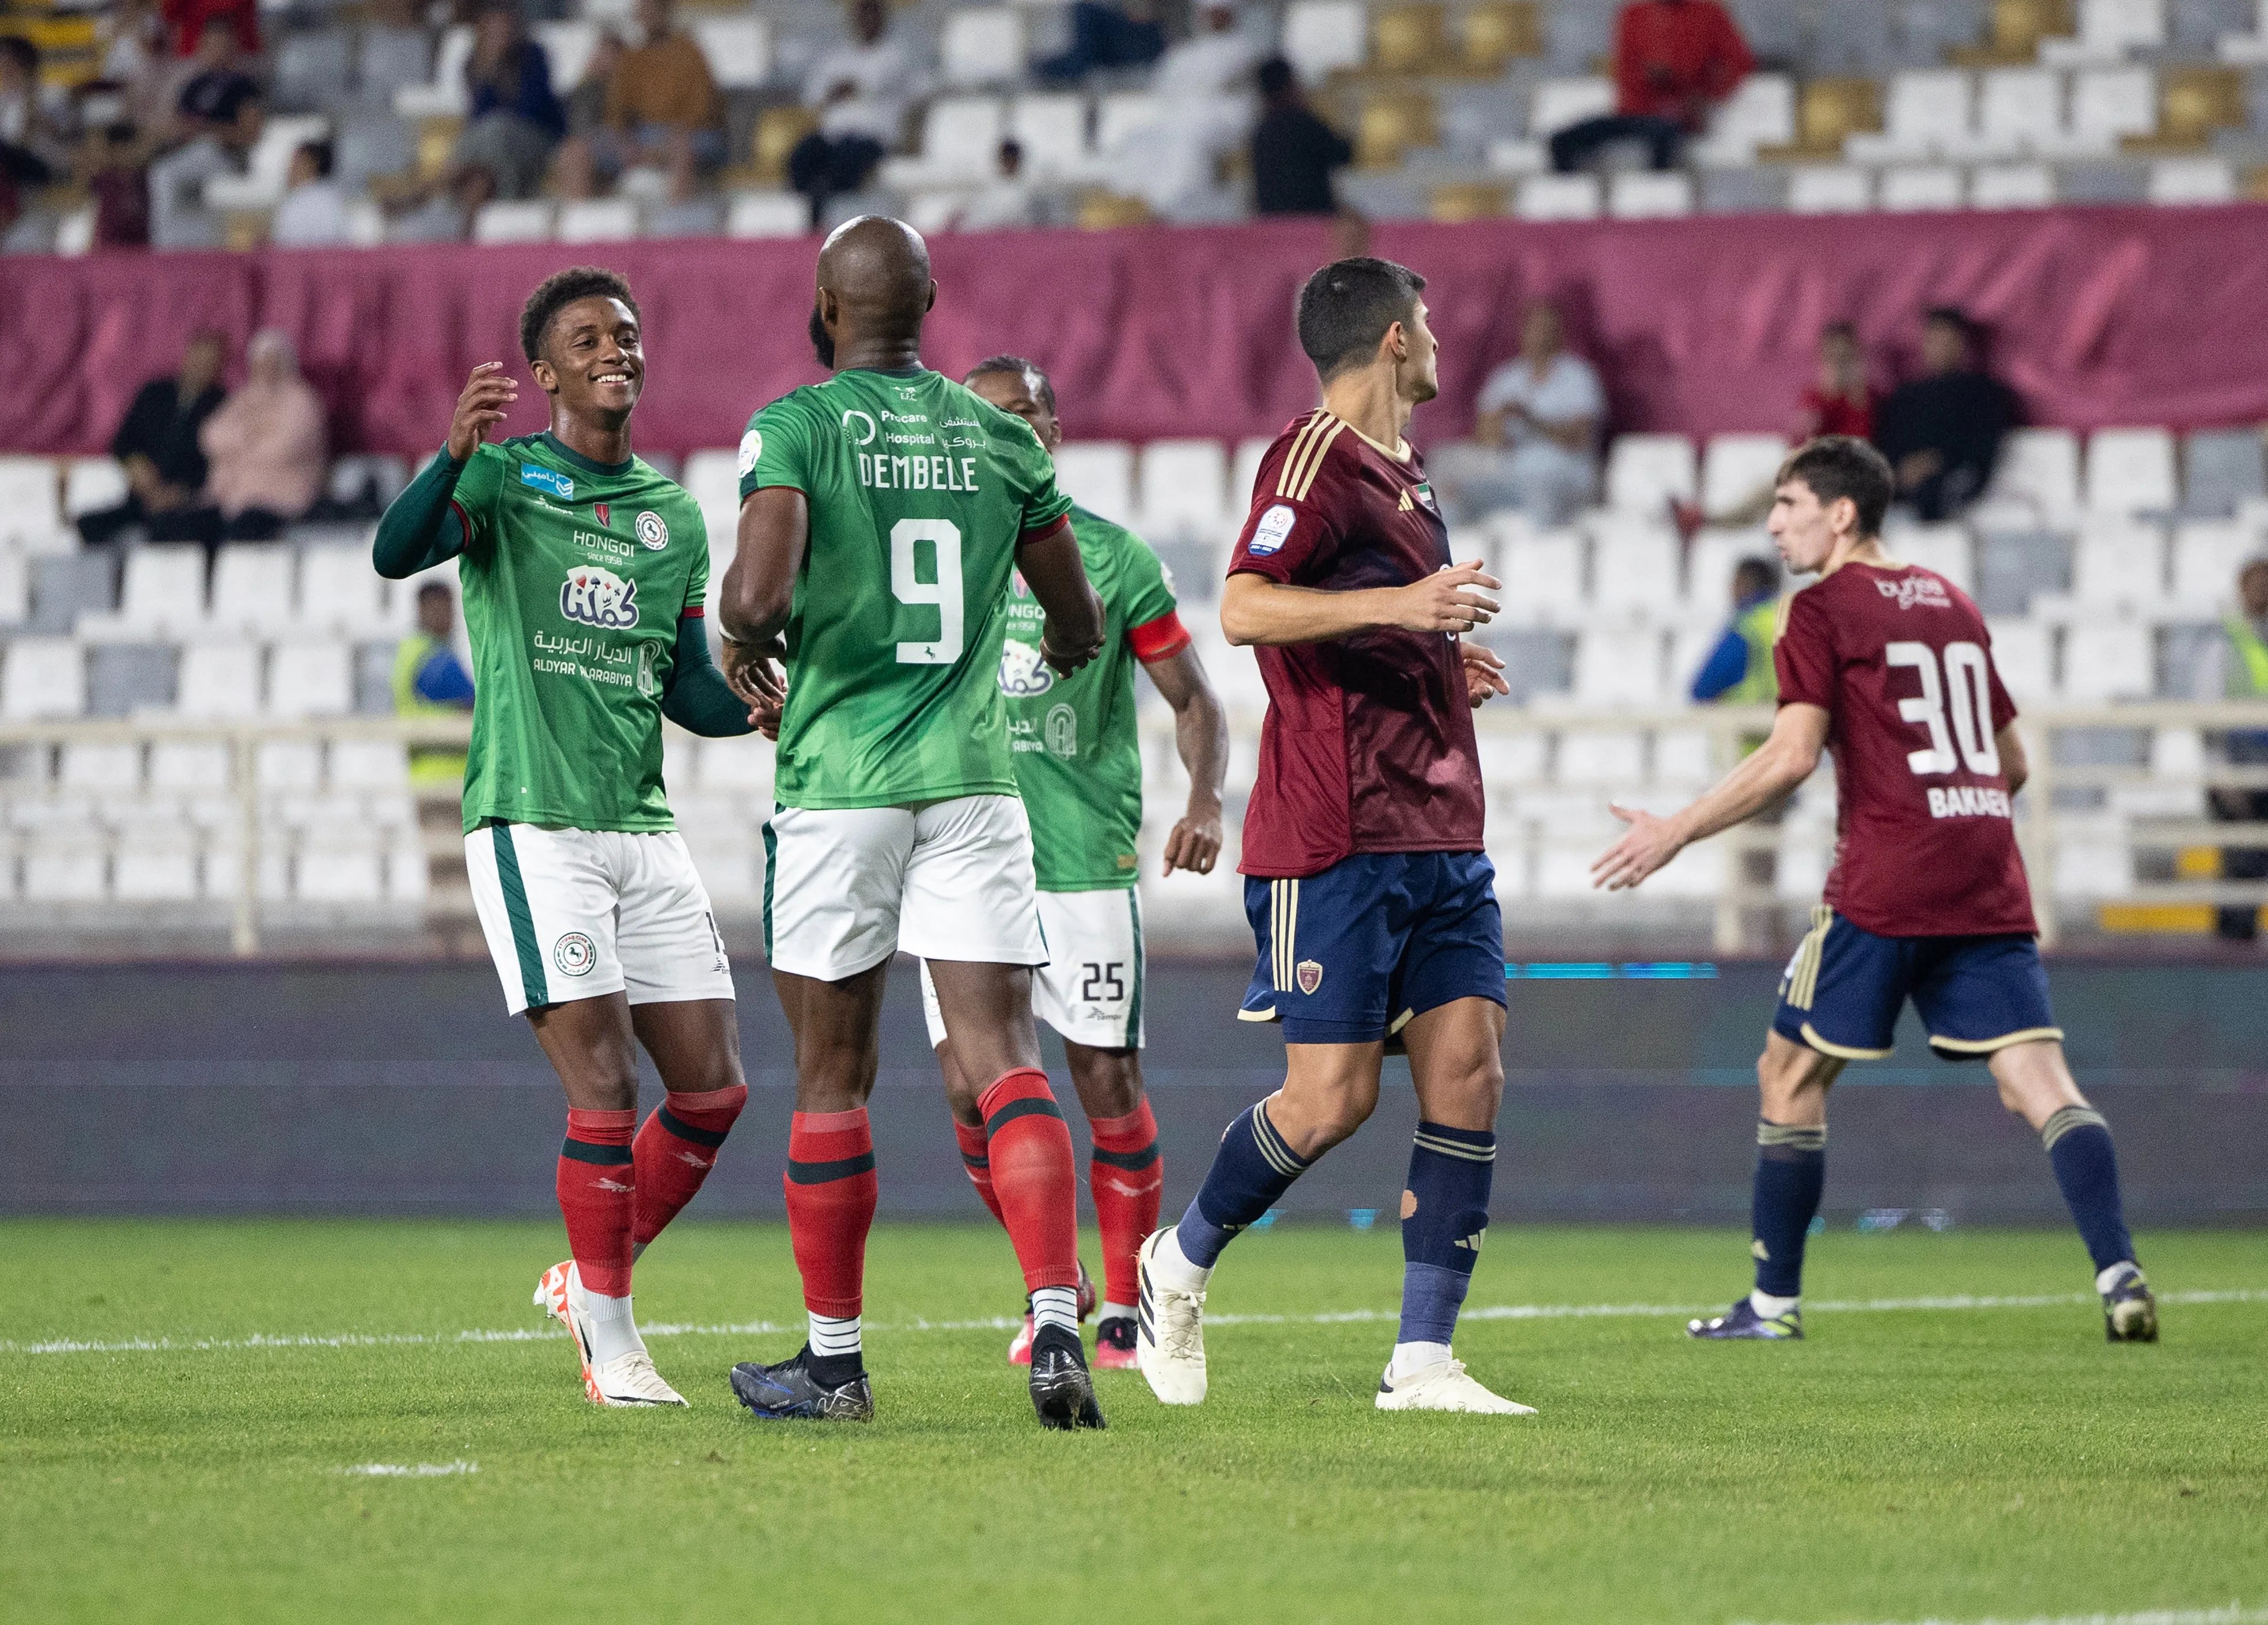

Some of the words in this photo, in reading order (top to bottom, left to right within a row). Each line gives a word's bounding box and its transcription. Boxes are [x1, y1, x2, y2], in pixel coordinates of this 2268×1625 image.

[881, 410, 927, 423] Procare
[885, 432, 935, 446] Hospital
[858, 453, 979, 491] DEMBELE
[573, 530, 634, 558] HONGQI
[890, 519, 964, 664] 9
[533, 630, 593, 655] العربية
[593, 641, 632, 664] الديار
[533, 659, 575, 675] ALDYAR
[1885, 641, 2001, 776] 30
[1082, 963, 1123, 1002] 25
